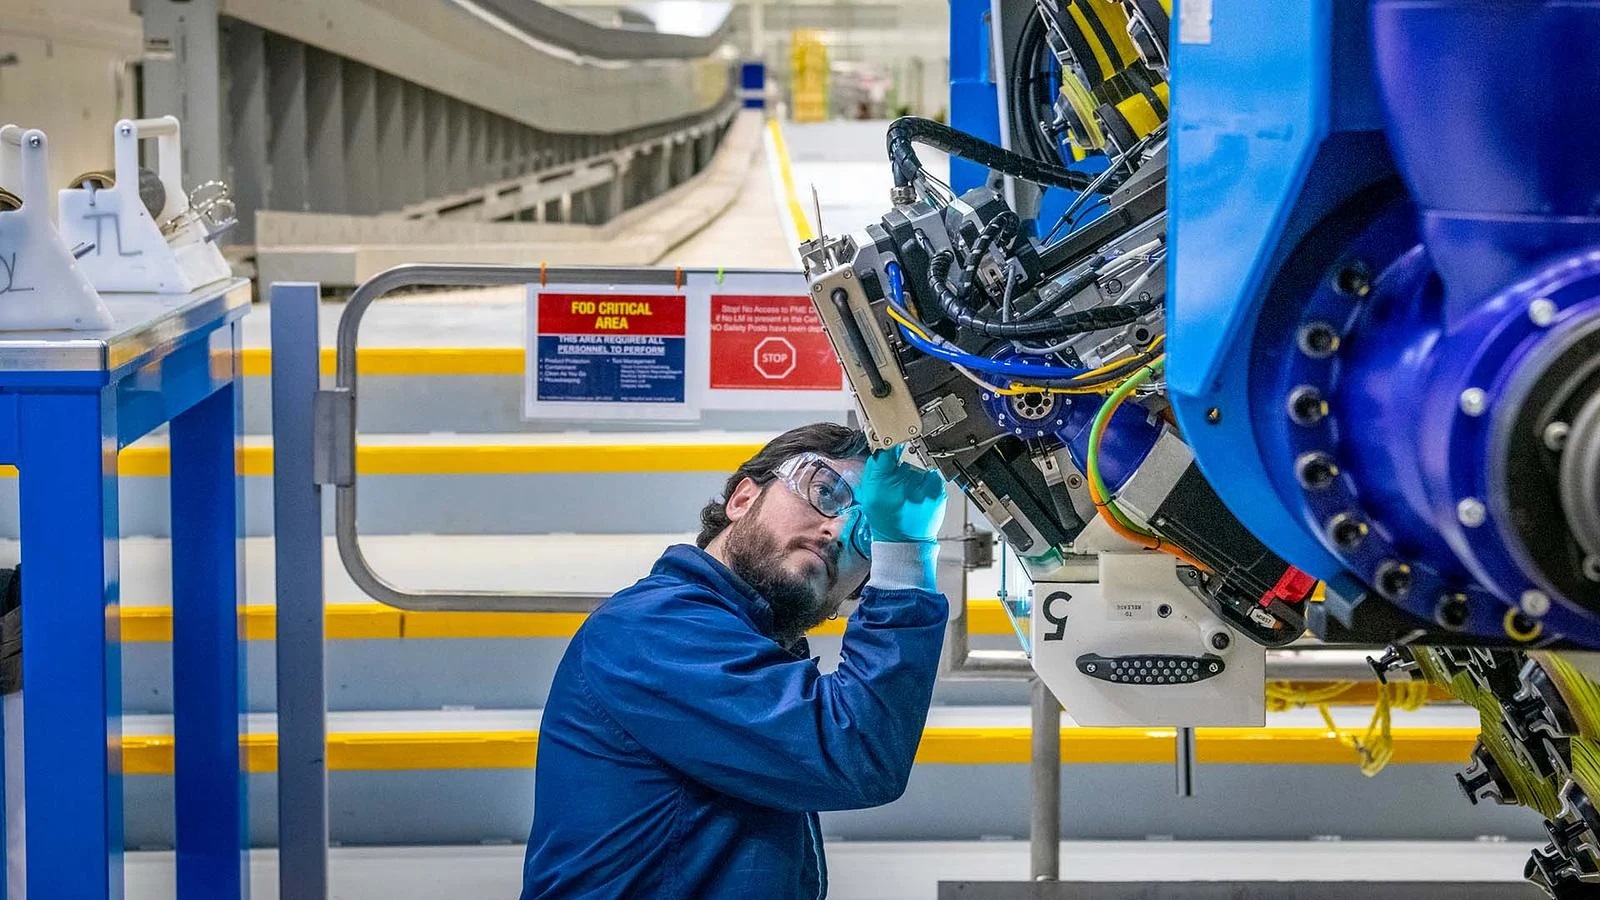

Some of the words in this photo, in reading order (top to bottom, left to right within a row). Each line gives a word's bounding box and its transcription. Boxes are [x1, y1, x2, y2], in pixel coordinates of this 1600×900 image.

[82, 213, 143, 256] TL
[571, 301, 596, 314] FOD
[598, 301, 653, 316] CRITICAL
[742, 305, 753, 314] No
[754, 305, 780, 314] Access
[595, 316, 629, 329] AREA
[722, 314, 733, 323] No
[747, 315, 753, 323] is
[754, 316, 781, 325] present
[783, 315, 790, 323] in
[791, 315, 802, 323] the
[723, 323, 746, 333] Safety
[747, 323, 768, 332] Posts
[579, 336, 603, 344] AREA
[604, 337, 647, 345] REQUIRES
[648, 337, 665, 345] ALL
[558, 344, 608, 353] PERSONNEL
[610, 345, 622, 353] TO
[623, 346, 665, 354] PERFORM
[762, 353, 788, 363] STOP
[1042, 591, 1073, 641] 5
